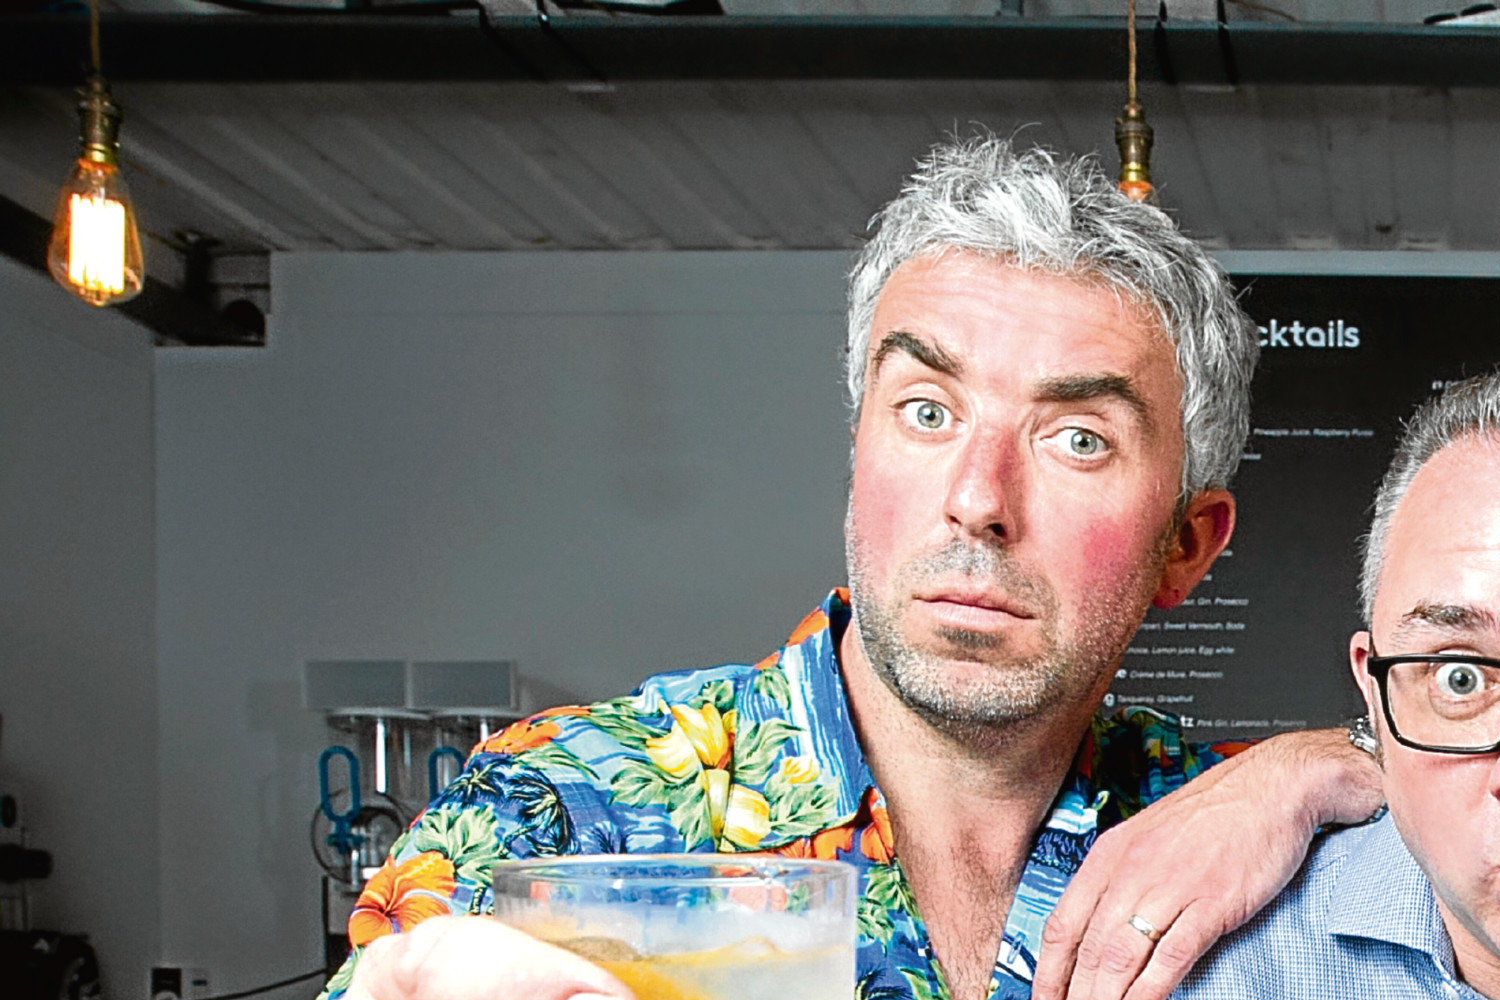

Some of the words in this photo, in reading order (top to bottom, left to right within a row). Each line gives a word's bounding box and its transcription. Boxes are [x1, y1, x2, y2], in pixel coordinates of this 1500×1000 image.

[1151, 647, 1177, 655] Lemon
[1198, 646, 1214, 656] Egg
[1215, 646, 1236, 655] white
[1189, 670, 1224, 679] Prosecco
[1157, 694, 1194, 704] Grapefruit
